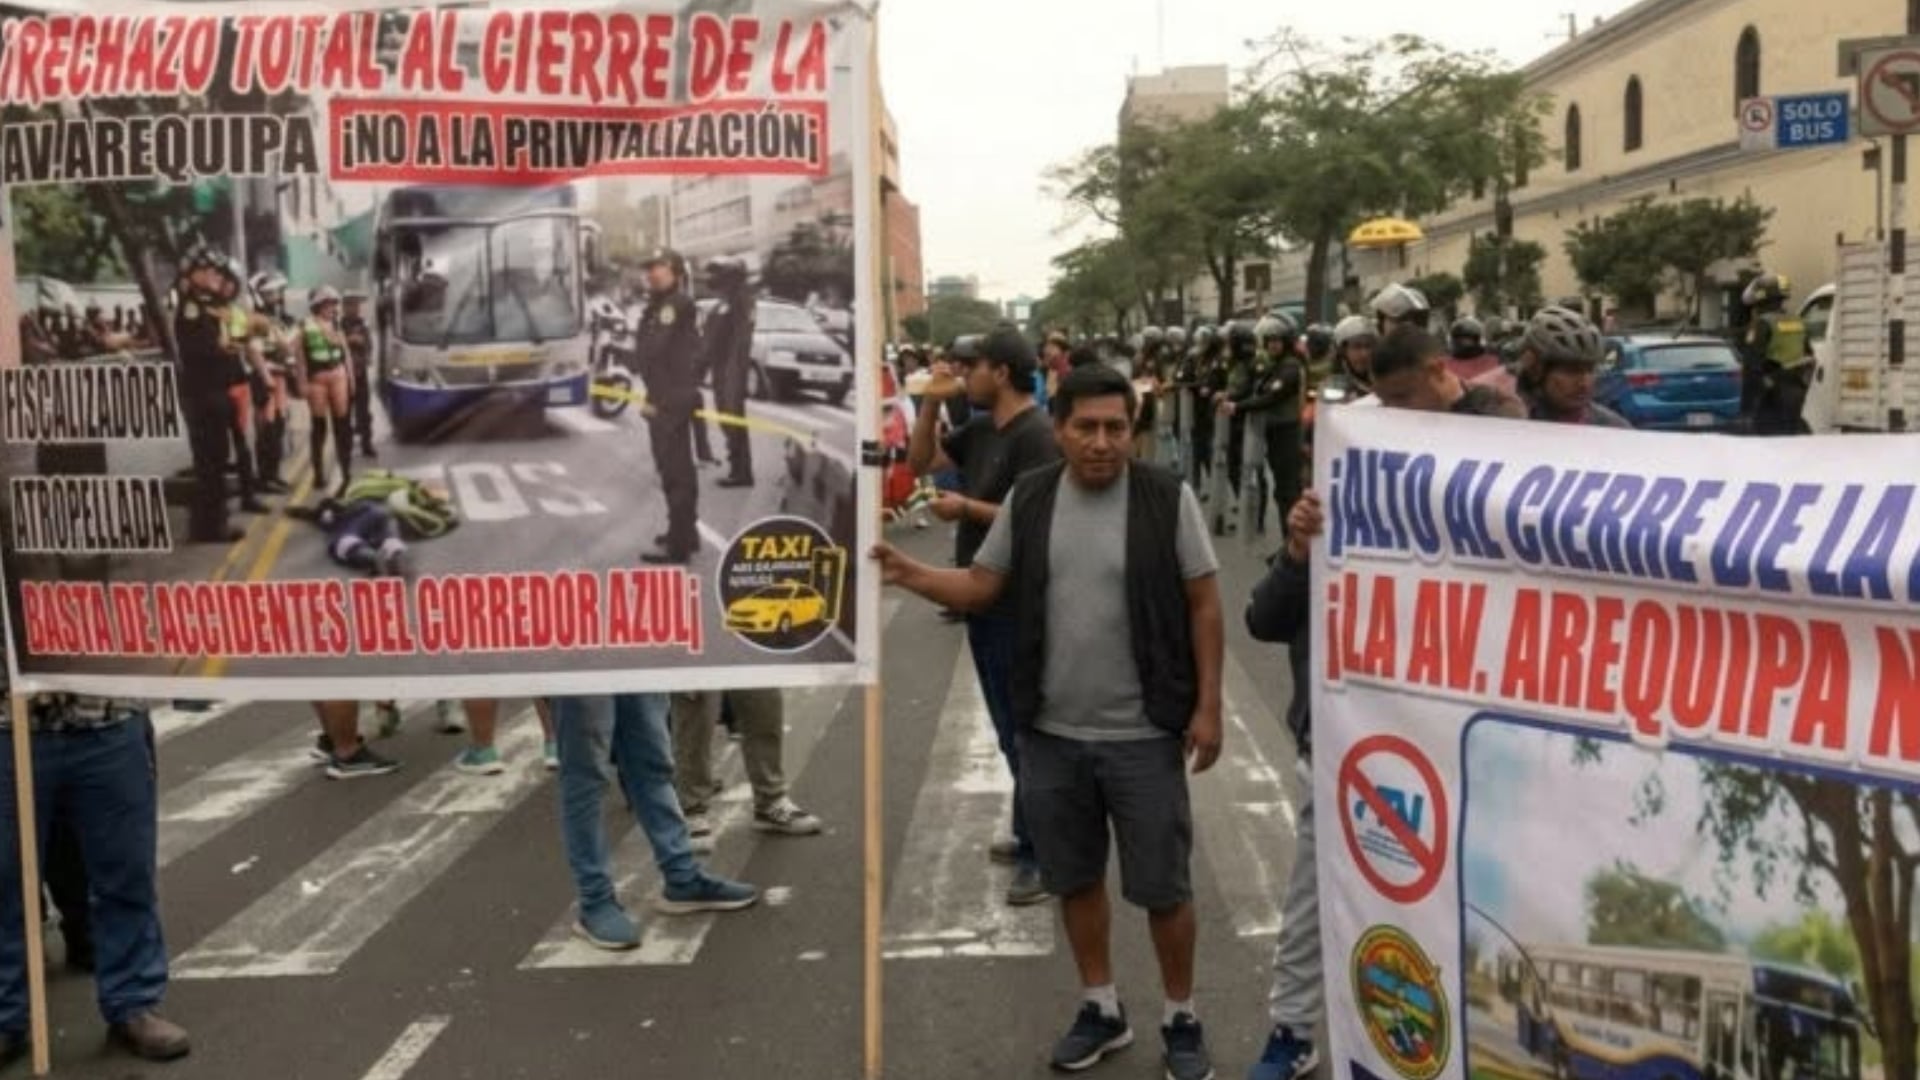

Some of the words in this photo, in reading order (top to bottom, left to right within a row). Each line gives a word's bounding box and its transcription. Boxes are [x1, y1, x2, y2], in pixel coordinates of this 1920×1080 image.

[1, 15, 217, 105] ¡RECHAZO
[234, 13, 383, 91] TOTAL
[402, 12, 464, 91] AL
[483, 12, 675, 104] CIERRE
[690, 15, 760, 98] DE
[771, 20, 827, 93] LA
[343, 115, 406, 168] ¡NO
[417, 116, 442, 165] A
[453, 117, 495, 166] LA
[1783, 100, 1842, 120] SOLO
[1790, 122, 1834, 140] BUS
[5, 365, 180, 438] FISCALIZADORA
[14, 478, 170, 550] ATROPELLADA
[741, 535, 812, 559] TAXI
[1331, 448, 1440, 556] ¡ALTO
[1445, 460, 1504, 559] AL
[1506, 465, 1723, 582] CIERRE
[1711, 482, 1822, 592] DE
[1808, 485, 1915, 599] LA
[24, 583, 112, 652] BASTA
[112, 584, 153, 651] DE
[158, 582, 348, 653] ACCIDENTES
[353, 579, 412, 652] DEL
[418, 573, 599, 650] CORREDOR
[1328, 573, 1396, 680] ¡LA
[1408, 580, 1487, 693] AV.
[1501, 589, 1850, 750] AREQUIPA
